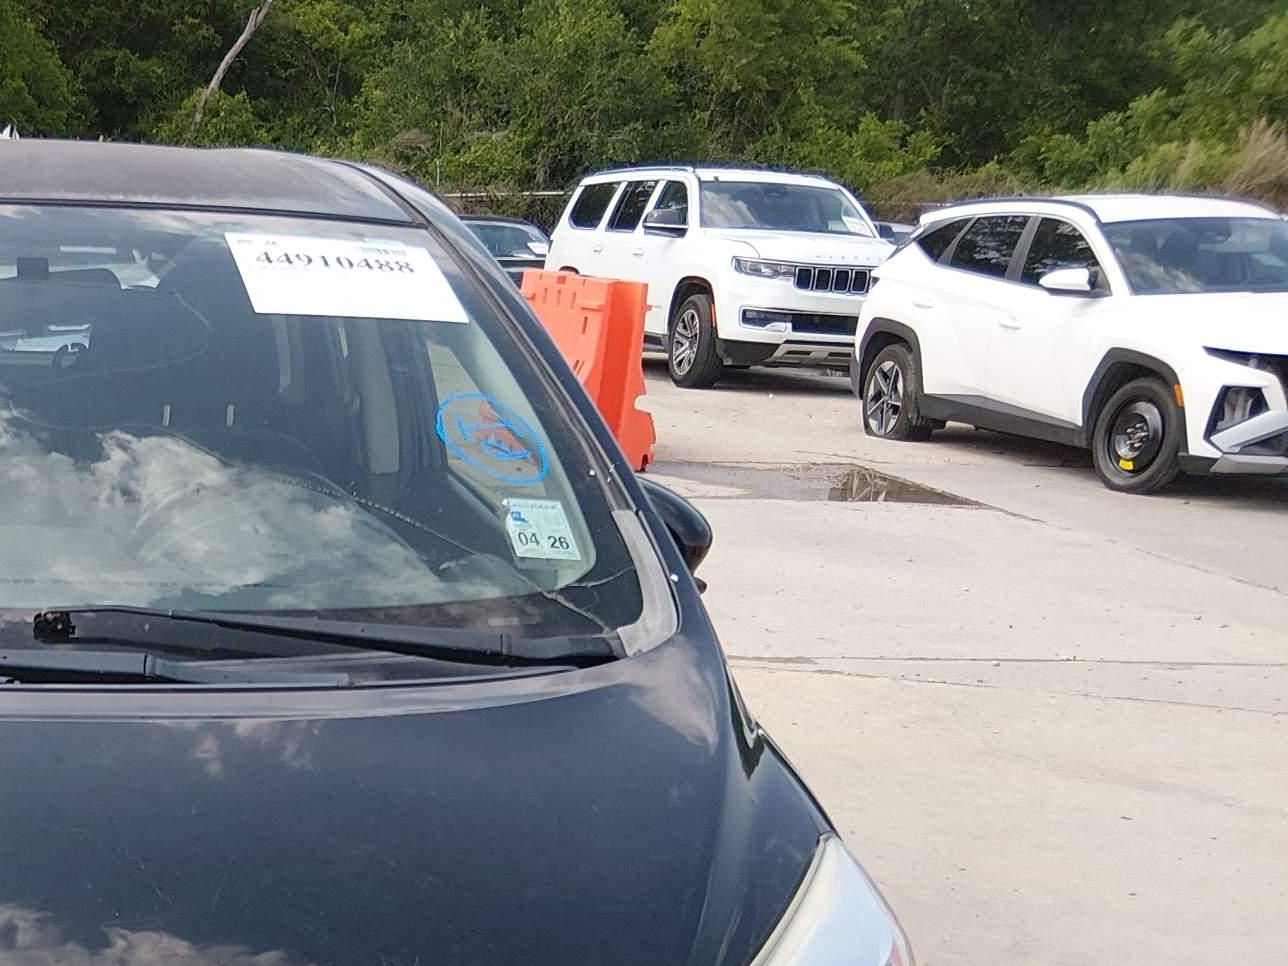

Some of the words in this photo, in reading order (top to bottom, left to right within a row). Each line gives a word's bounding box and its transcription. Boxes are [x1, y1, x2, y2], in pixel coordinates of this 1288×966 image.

[255, 250, 416, 274] 44910488
[518, 532, 540, 547] 04
[547, 535, 570, 550] 26
